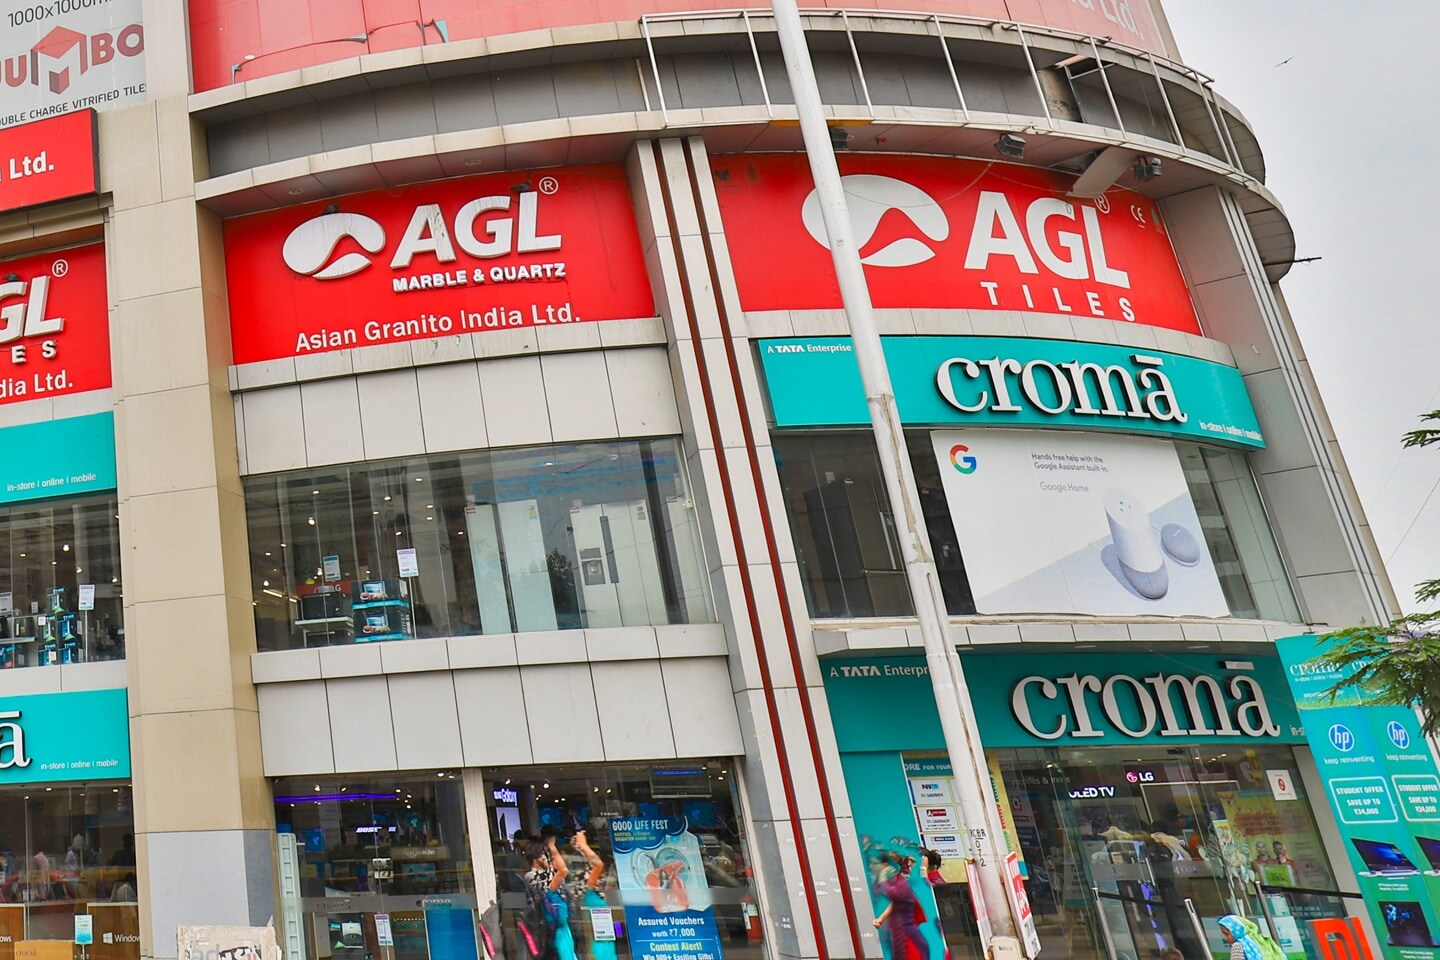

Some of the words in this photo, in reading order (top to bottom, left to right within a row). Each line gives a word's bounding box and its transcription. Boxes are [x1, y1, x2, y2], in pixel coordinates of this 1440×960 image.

[29, 102, 68, 120] CHARGE
[72, 89, 120, 109] VITRIFIED
[9, 151, 55, 180] Ltd.
[389, 189, 562, 269] AGL
[963, 190, 1131, 289] AGL
[392, 269, 468, 293] MARBLE
[473, 269, 486, 284] &
[490, 262, 567, 282] QUARTZ
[980, 281, 1136, 322] TILES
[295, 326, 357, 353] Asian
[364, 314, 453, 342] Granito
[460, 306, 523, 330] India
[531, 302, 581, 326] Ltd.
[775, 344, 805, 353] TATA
[806, 343, 852, 354] Enterprise
[32, 369, 74, 394] Ltd.
[1200, 420, 1224, 433] in-store
[1031, 452, 1052, 462] Hands
[1066, 453, 1079, 464] help
[1034, 462, 1058, 472] Google
[1058, 462, 1086, 472] Assistant
[7, 479, 35, 492] in-store
[41, 476, 65, 488] online
[70, 472, 96, 484] mobile
[1040, 481, 1066, 493] Google
[1067, 483, 1089, 493] Home
[830, 667, 839, 678] A
[840, 665, 881, 677] TATA
[1340, 755, 1375, 764] reinventing
[1399, 754, 1428, 762] reinventing
[41, 761, 65, 770] in-store
[70, 760, 91, 769] online
[96, 759, 119, 769] mobile
[1099, 786, 1116, 797] TV
[1336, 787, 1363, 795] STUDENT
[612, 821, 632, 831] GOOD
[634, 820, 649, 830] LIFE
[651, 819, 669, 830] FEST
[638, 917, 668, 926] Assured
[669, 916, 704, 926] Vouchers
[650, 942, 679, 952] Contest
